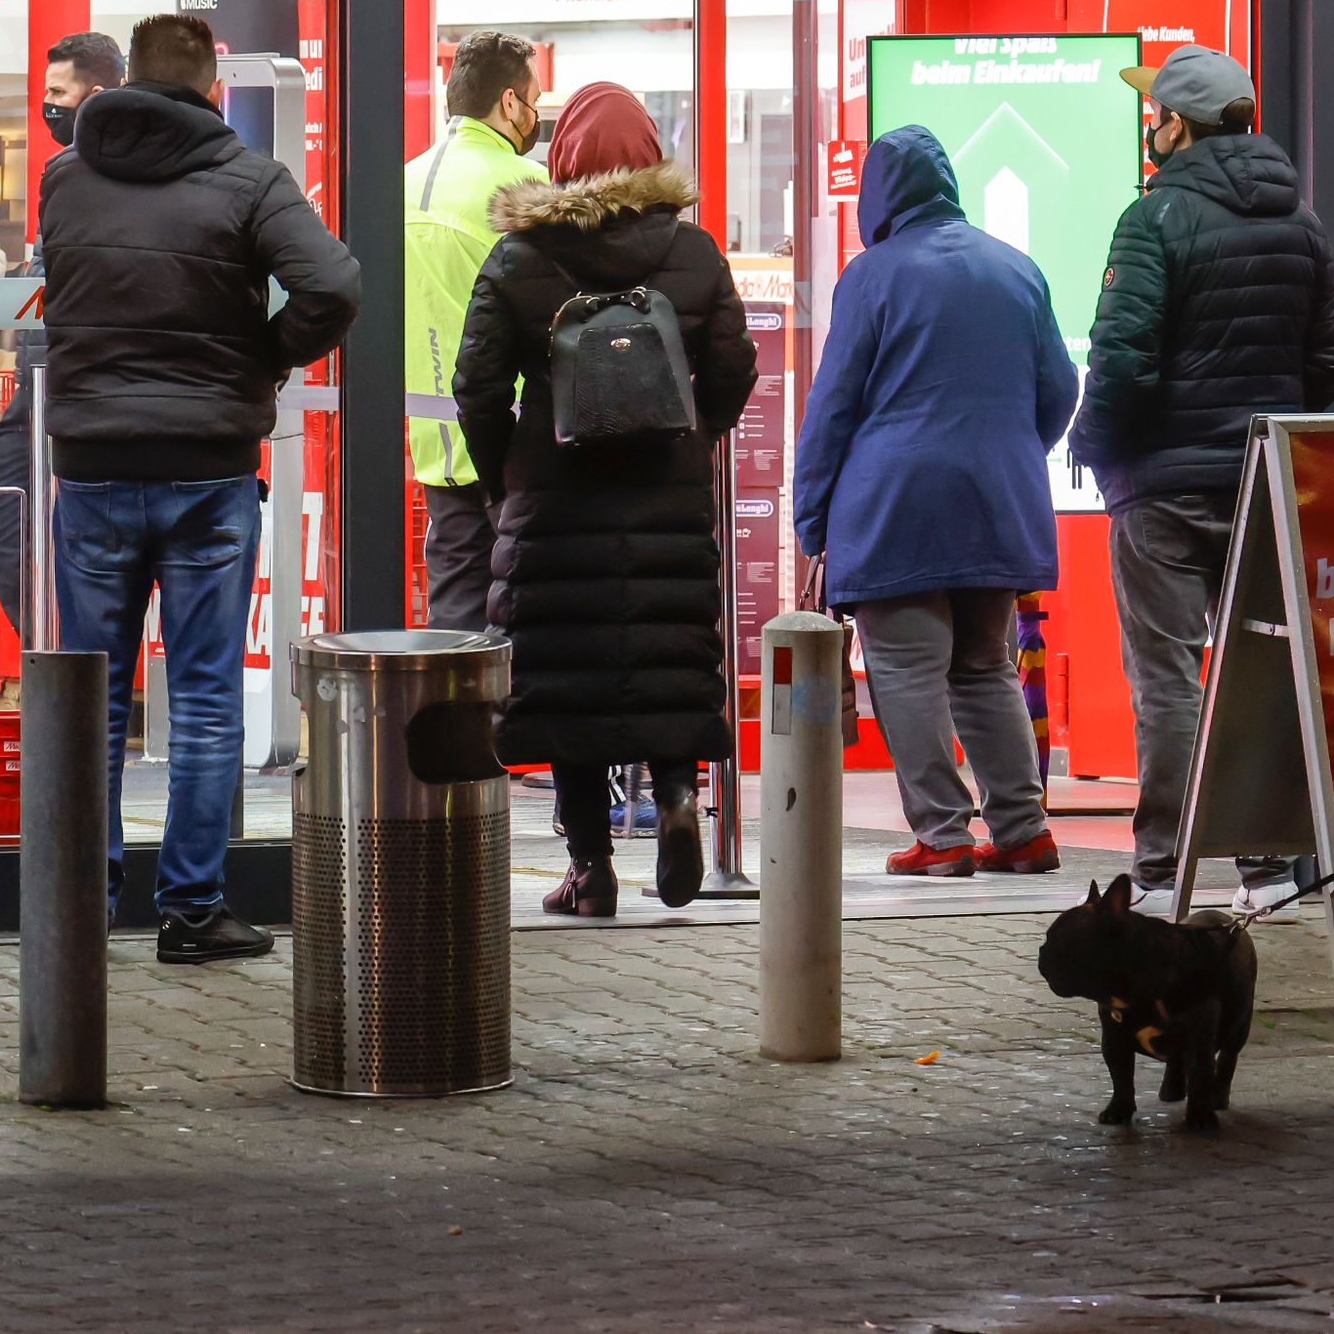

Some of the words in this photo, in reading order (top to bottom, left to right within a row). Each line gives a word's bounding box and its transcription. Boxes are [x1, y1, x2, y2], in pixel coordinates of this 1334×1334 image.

[1159, 27, 1195, 43] Kunden,
[911, 60, 970, 86] beim
[973, 59, 1101, 85] Einkaufen!
[747, 317, 777, 328] Longhi
